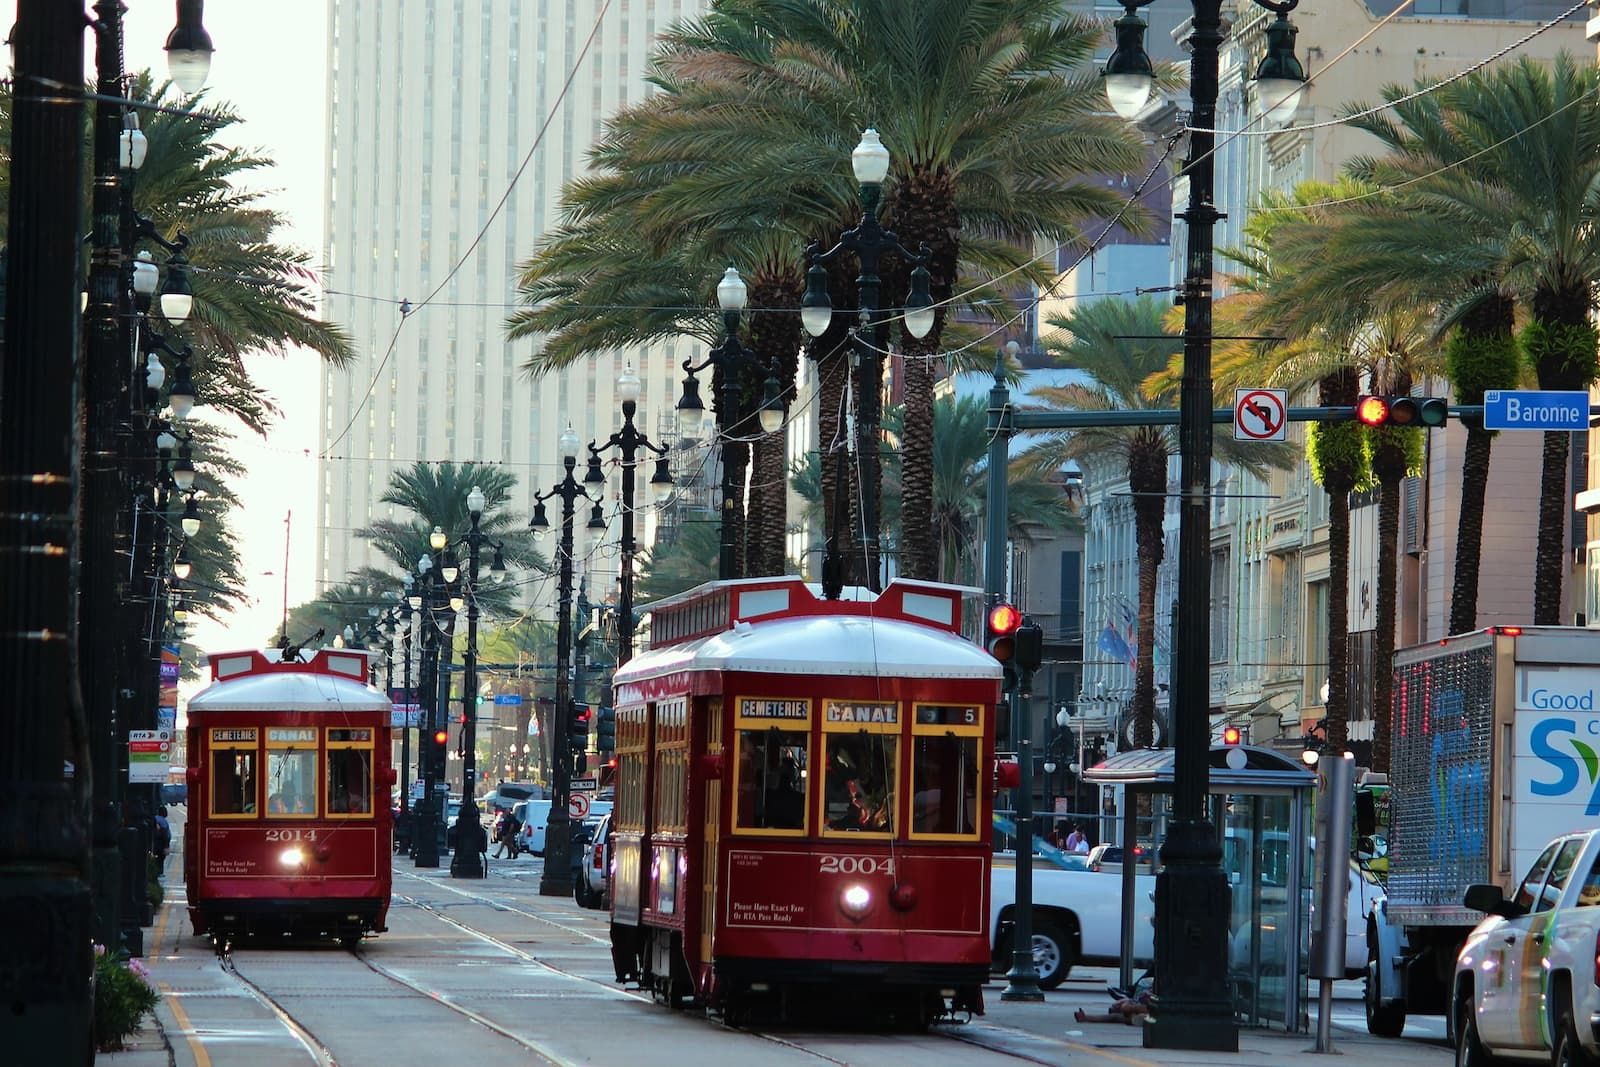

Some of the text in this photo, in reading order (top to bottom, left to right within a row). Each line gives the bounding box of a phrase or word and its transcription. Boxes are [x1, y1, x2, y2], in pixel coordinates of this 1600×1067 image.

[1506, 398, 1580, 422] Baronne
[1532, 689, 1593, 710] Good
[742, 700, 808, 717] CEMETERIES
[828, 705, 896, 723] CANAL
[965, 709, 974, 722] 5
[213, 730, 256, 741] CEMETERIES
[269, 730, 315, 741] CANAL
[265, 829, 318, 841] 2014
[819, 855, 895, 875] 2004
[734, 902, 804, 912] Please Have Exact Fare
[733, 912, 792, 922] Or RTA Pass Ready
